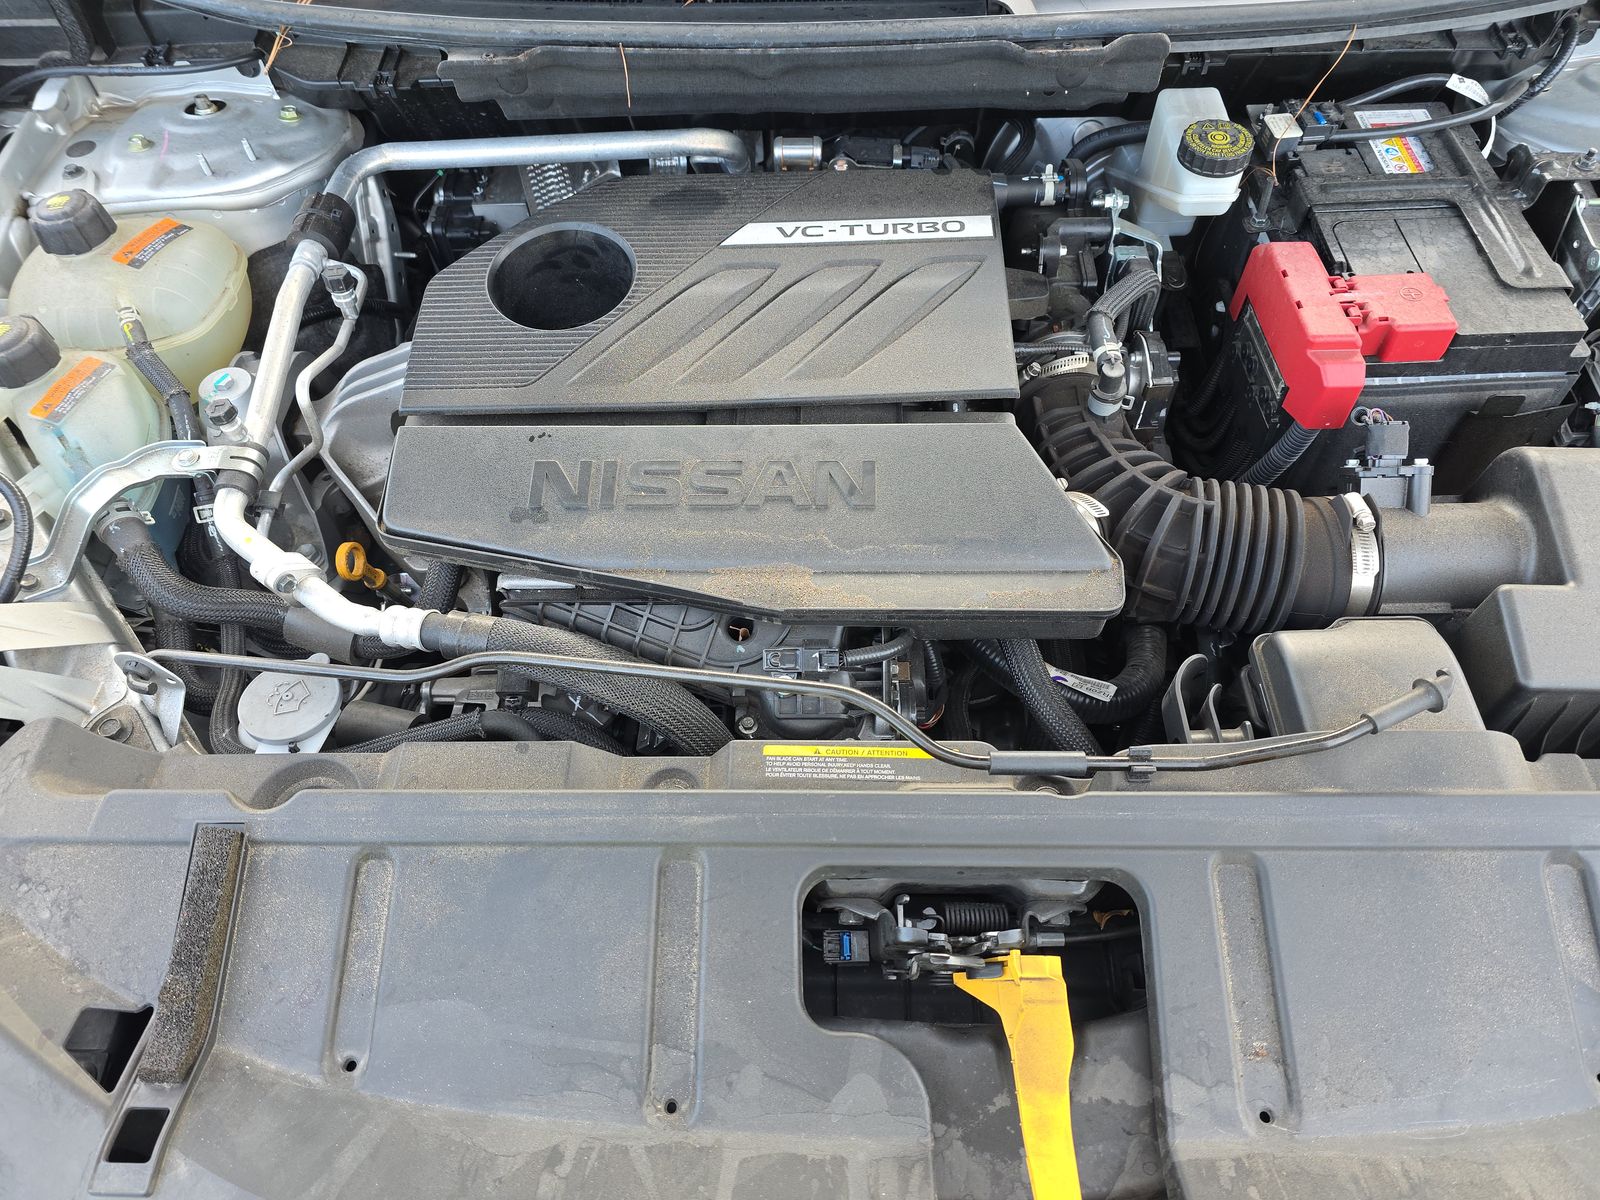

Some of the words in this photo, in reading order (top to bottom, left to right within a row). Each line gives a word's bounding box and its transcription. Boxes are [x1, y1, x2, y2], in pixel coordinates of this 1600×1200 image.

[775, 220, 967, 238] VC-TURBO
[527, 460, 876, 510] NISSAN
[825, 748, 859, 756] CAUTION
[867, 749, 908, 757] ATTENTION
